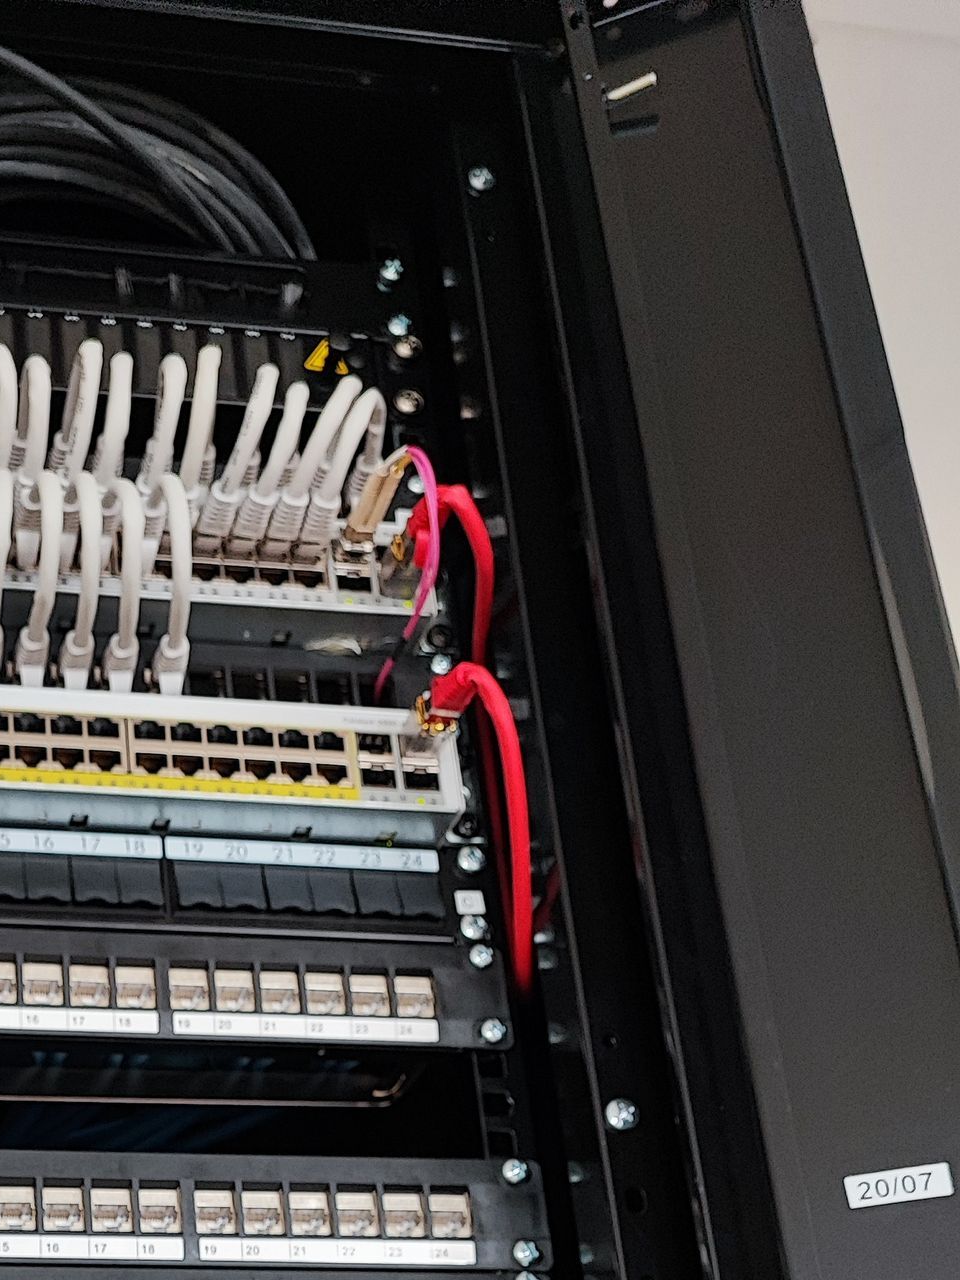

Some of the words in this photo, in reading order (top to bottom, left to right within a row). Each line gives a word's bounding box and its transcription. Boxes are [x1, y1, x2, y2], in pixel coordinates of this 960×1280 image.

[33, 833, 54, 849] 16
[80, 835, 101, 851] 17
[124, 838, 145, 855] 18
[184, 841, 203, 856] 19
[225, 841, 248, 858] 20
[272, 845, 293, 860] 21
[313, 848, 335, 864] 22
[360, 850, 382, 865] 23
[857, 1172, 933, 1201] 20/07
[46, 1242, 60, 1254] 16
[94, 1243, 108, 1254] 17
[142, 1244, 155, 1255] 18
[203, 1244, 217, 1255] 19
[245, 1244, 260, 1256] 20
[293, 1245, 307, 1256] 21
[342, 1246, 356, 1257] 22
[434, 1247, 449, 1258] 24
